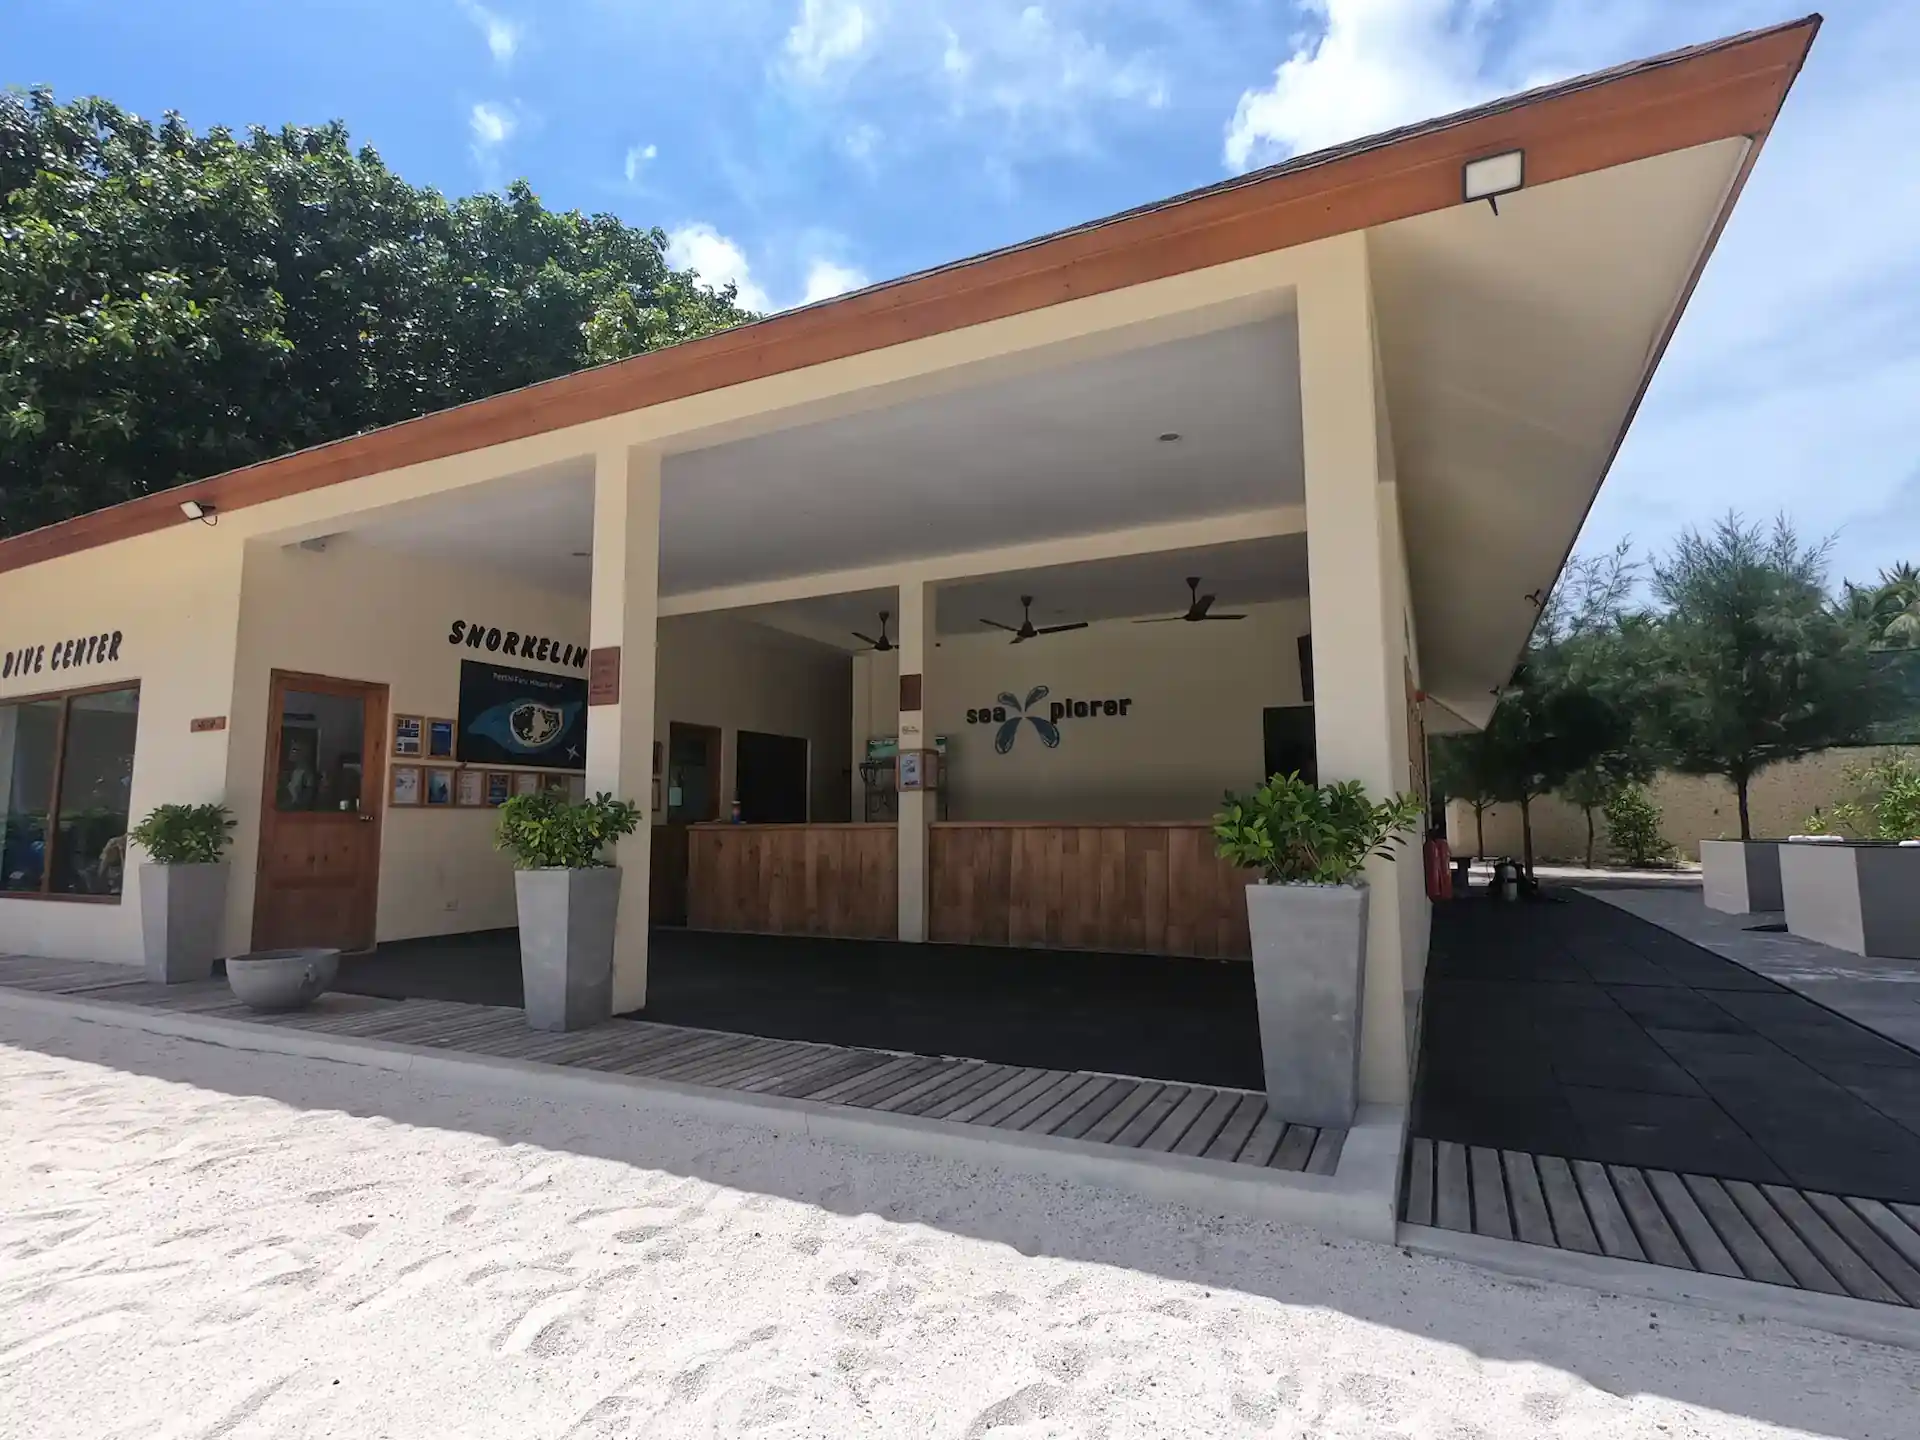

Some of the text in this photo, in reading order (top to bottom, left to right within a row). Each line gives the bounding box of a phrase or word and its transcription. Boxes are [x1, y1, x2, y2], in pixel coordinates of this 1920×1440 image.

[2, 630, 122, 679] DIVE CENTER
[448, 620, 588, 669] SNORKELIN
